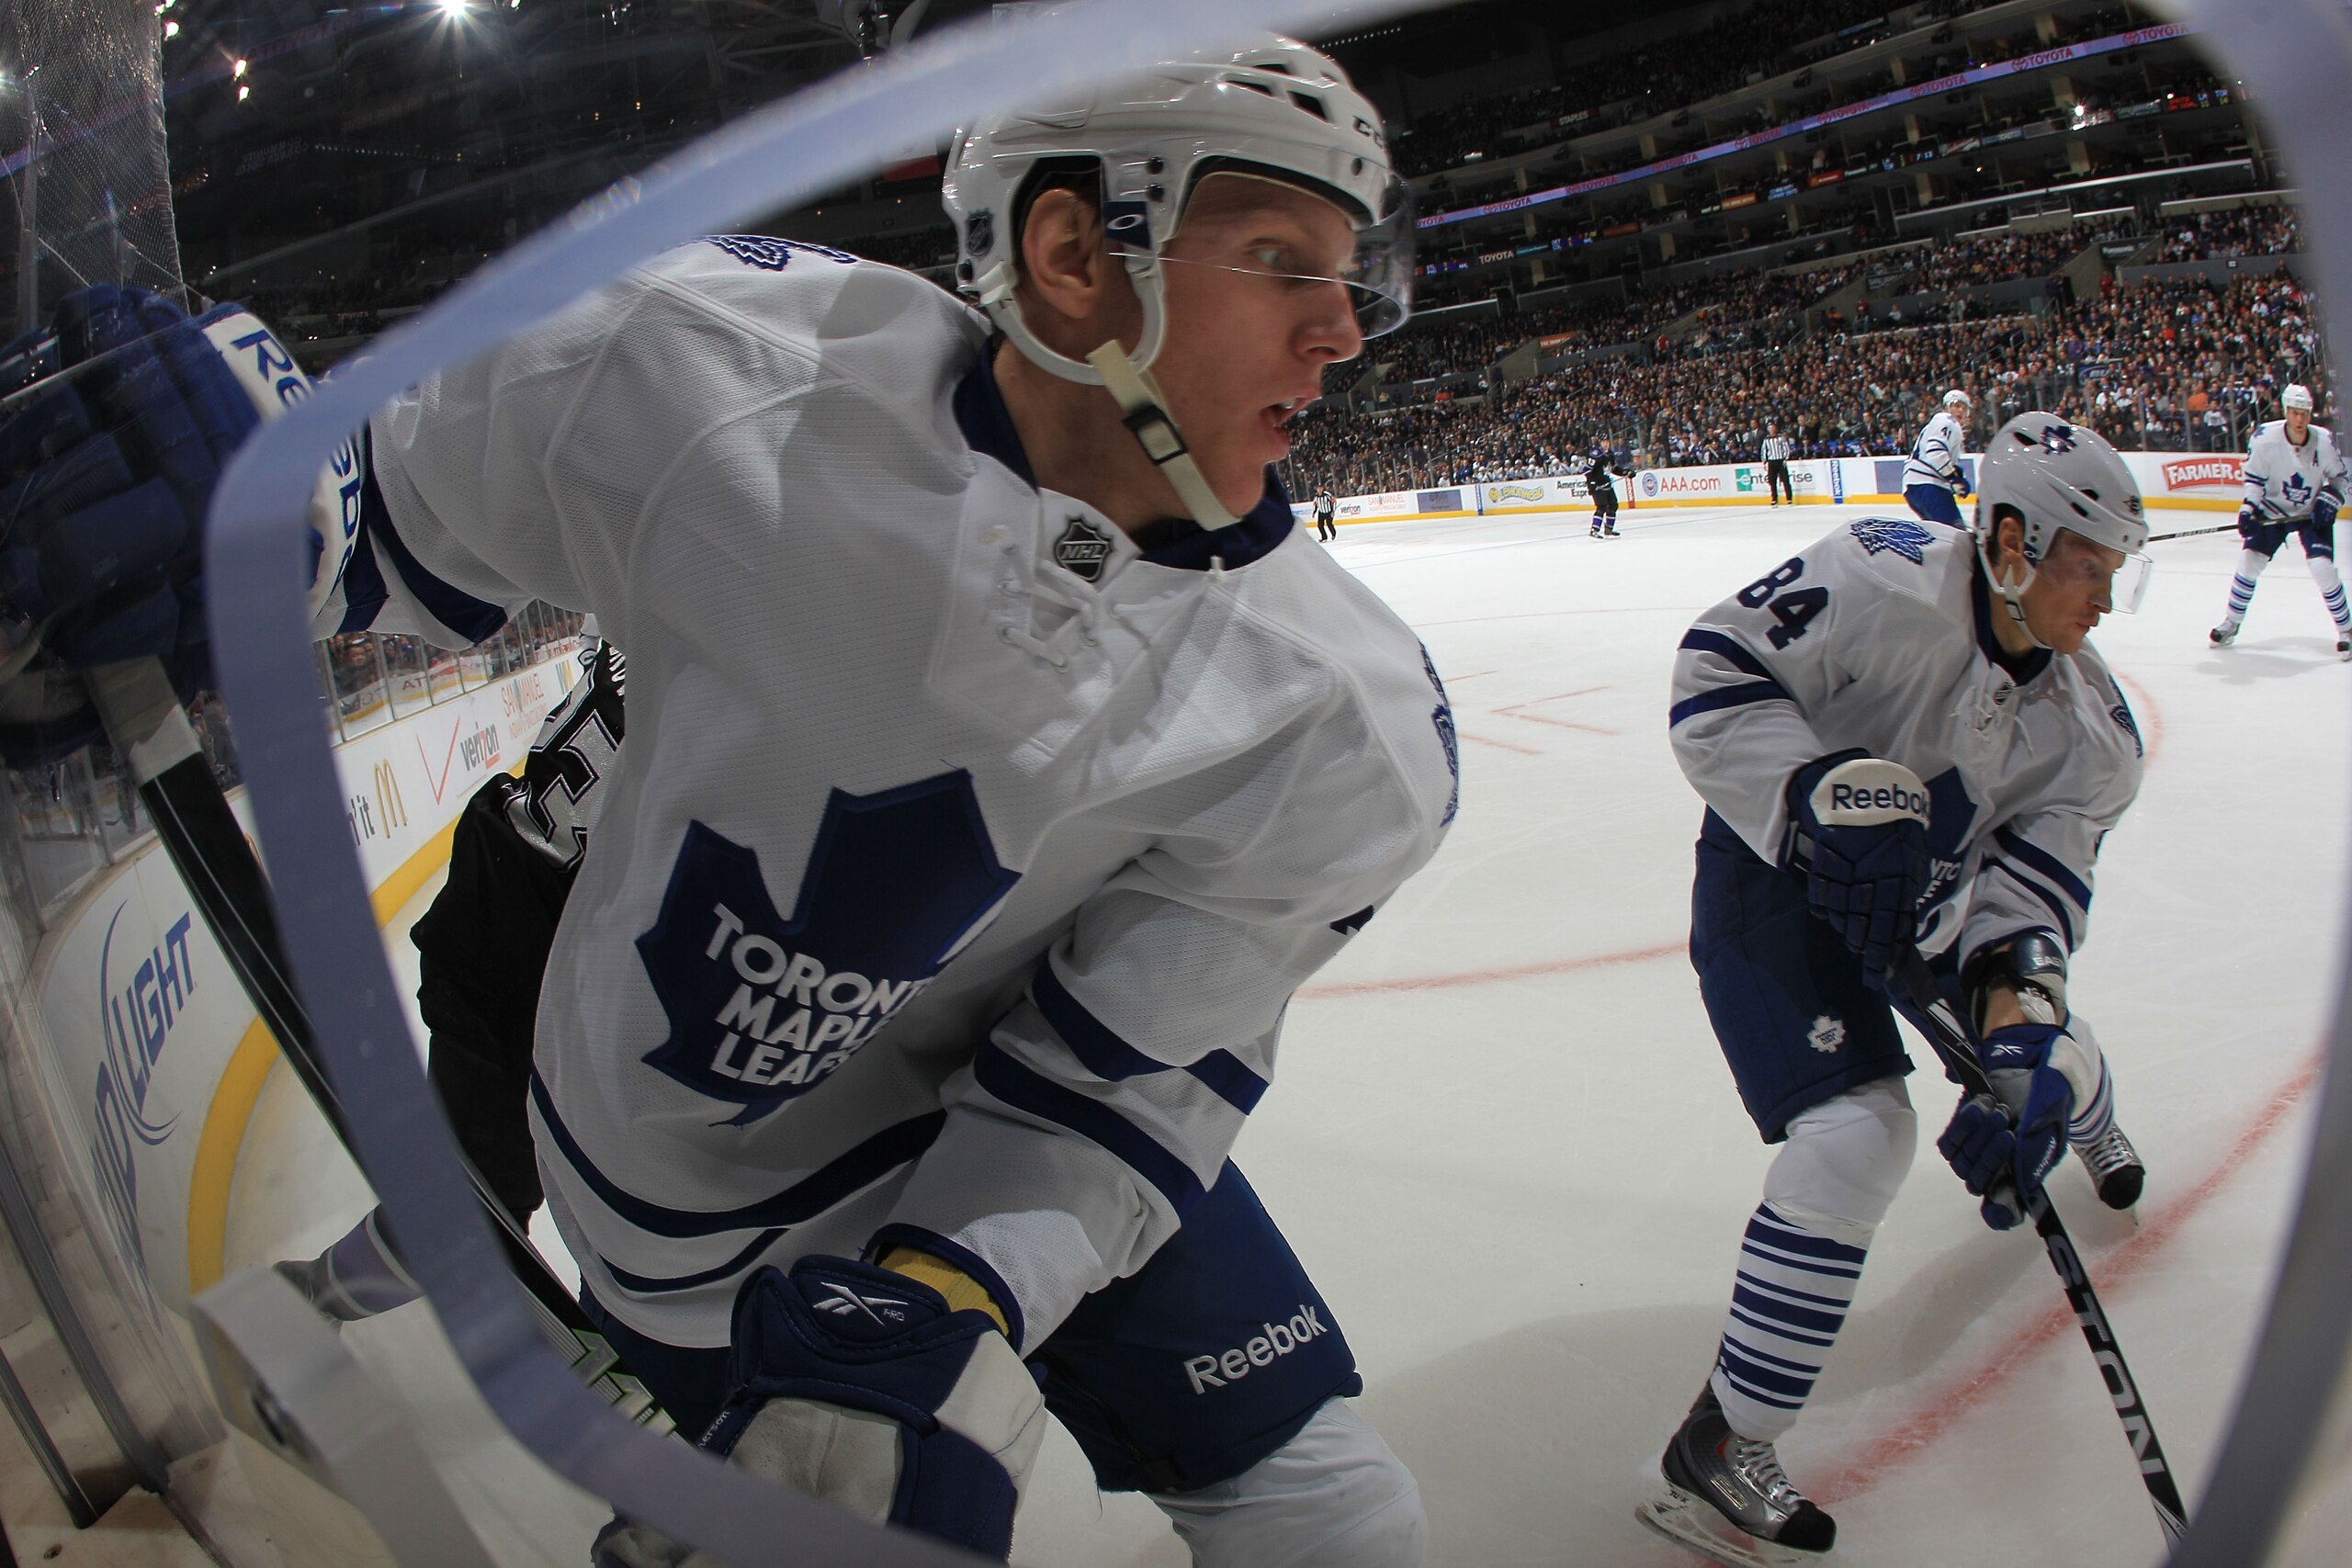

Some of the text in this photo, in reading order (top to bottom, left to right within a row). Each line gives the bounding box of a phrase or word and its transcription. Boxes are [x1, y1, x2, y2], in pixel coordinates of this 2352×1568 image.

[2141, 22, 2188, 41] TOYOTA
[2030, 48, 2073, 67] TOYOTA
[1930, 75, 1967, 93] TOYOTA
[1831, 99, 1870, 120] TOYOTA
[1351, 116, 1383, 149] CC
[1747, 128, 1781, 146] TOYOTA
[1664, 152, 1698, 169] TOYOTA
[1578, 176, 1617, 194] TOYOTA
[1498, 197, 1532, 212] TOYOTA
[1417, 216, 1444, 229] OYOTA
[1479, 250, 1514, 265] TOYOTA
[1831, 460, 1842, 495] Reebok
[2166, 463, 2233, 485] FARMER
[1557, 479, 1588, 490] America
[1660, 476, 1720, 492] AAA.com
[1572, 488, 1588, 499] Expr
[1340, 504, 1362, 514] verizon
[1061, 544, 1104, 558] NHL
[1735, 557, 1828, 650] 84
[460, 722, 500, 772] verizon
[705, 903, 928, 1017] TORONT
[111, 910, 192, 1120] LIGHT
[883, 1307, 905, 1322] PRO
[1183, 1303, 1329, 1395] Reebok
